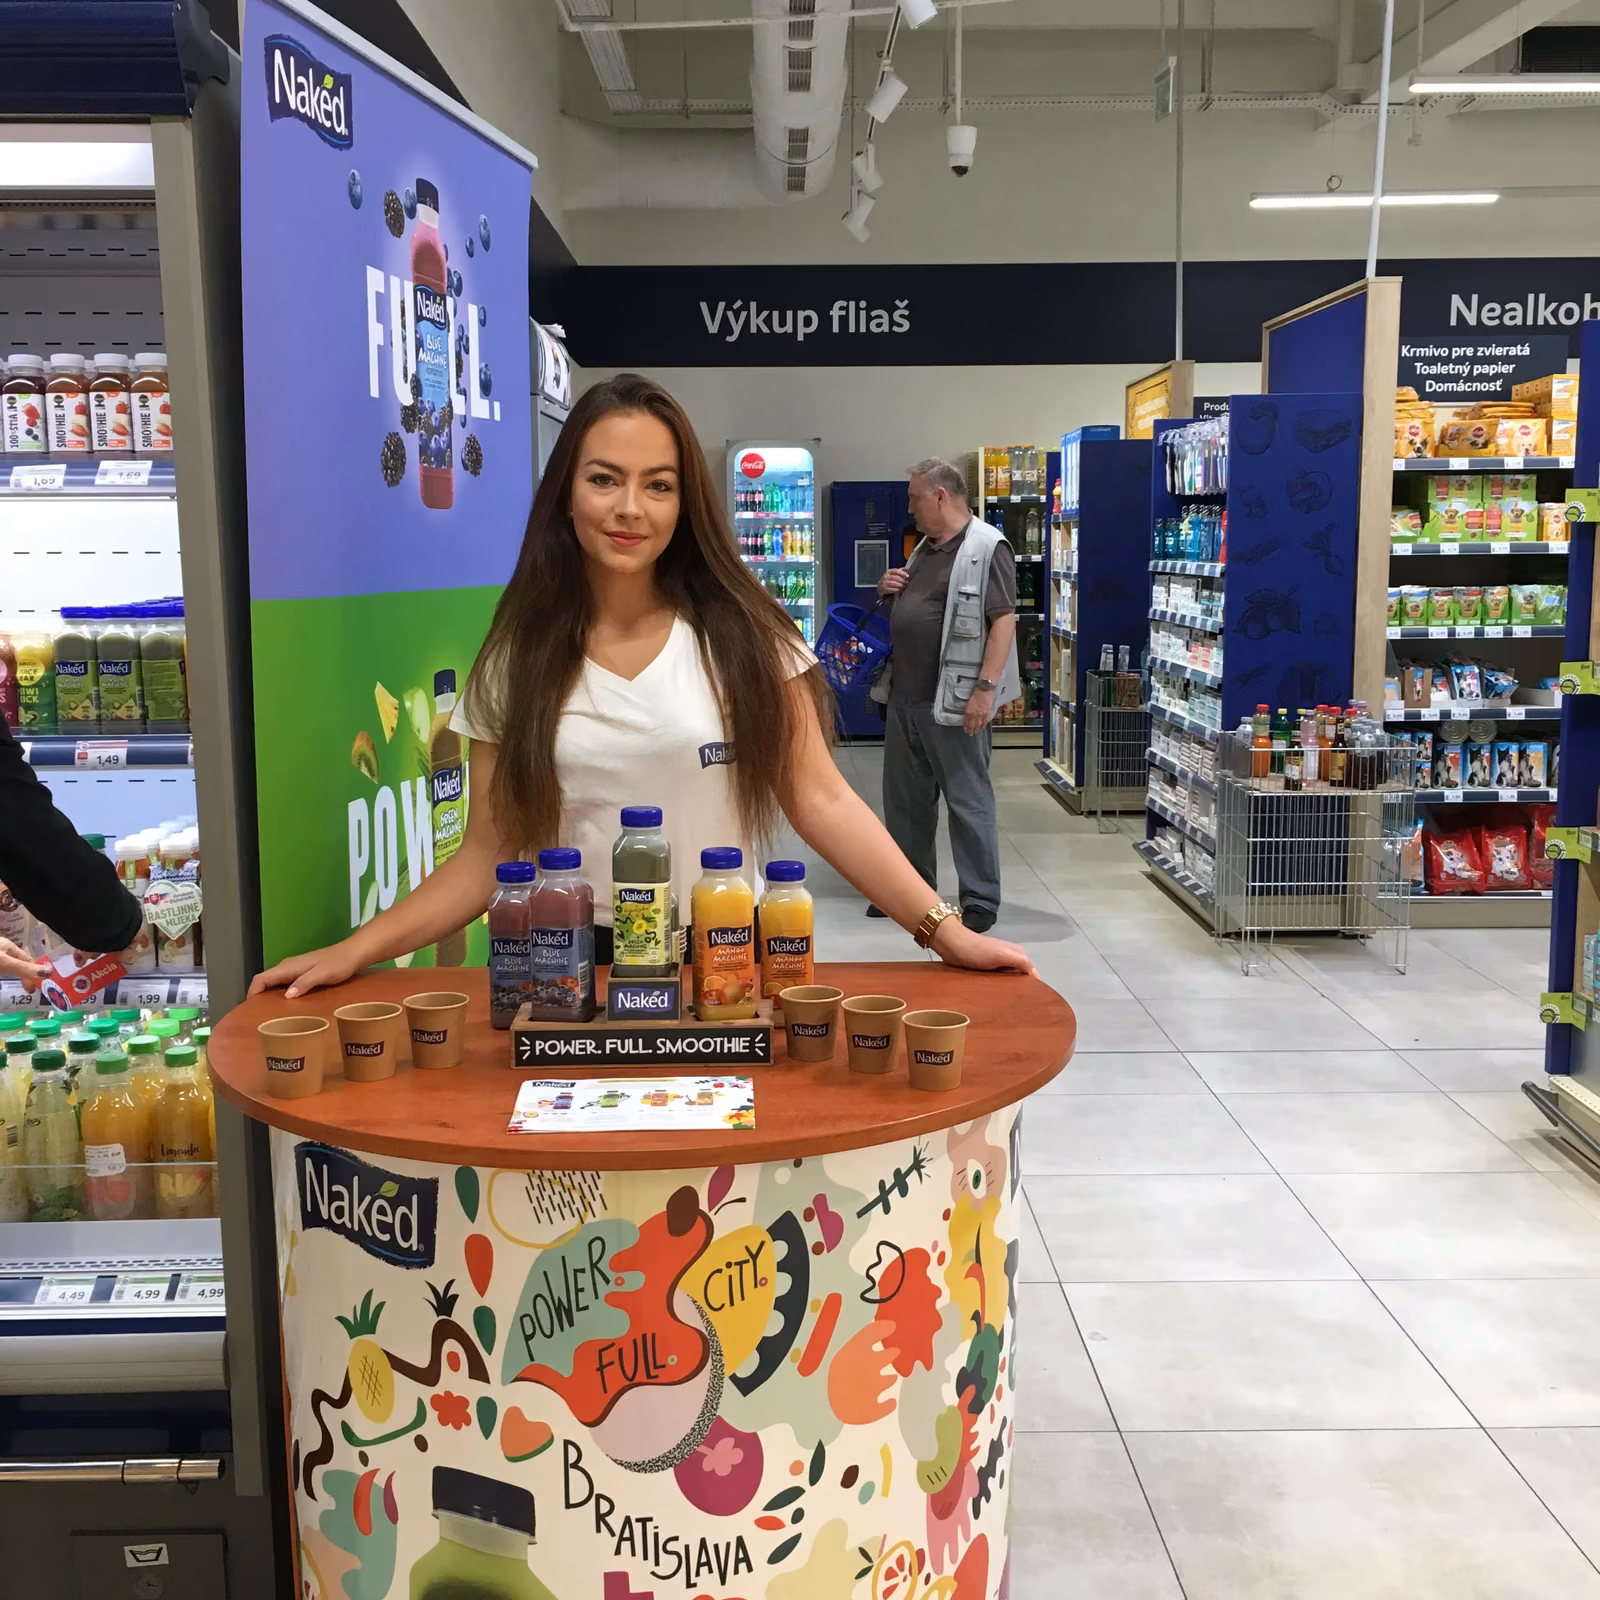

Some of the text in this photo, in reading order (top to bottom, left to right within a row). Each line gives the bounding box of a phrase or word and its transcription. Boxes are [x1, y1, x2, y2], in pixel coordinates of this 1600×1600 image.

[274, 48, 347, 136] Naked
[416, 290, 446, 323] Naked
[700, 299, 911, 342] Výkup fliaš
[1401, 343, 1531, 359] Krmivo pre zvieratá
[418, 348, 447, 369] MACHINE
[1414, 362, 1516, 377] Toaletný papier
[1425, 378, 1504, 392] Domácnosť
[56, 662, 85, 674] Naked
[100, 662, 128, 673] Naked
[97, 755, 119, 766] 1,49
[705, 746, 731, 764] Nak
[434, 775, 461, 801] Naked
[621, 890, 652, 902] Naked
[166, 914, 197, 927] MLIEKA
[532, 931, 569, 945] Naked
[711, 929, 749, 944] Naked
[494, 941, 530, 954] Naked
[770, 940, 806, 953] Naked
[542, 949, 561, 957] BLUE
[713, 953, 748, 962] MACHINE
[504, 957, 522, 965] BLUE
[534, 956, 569, 965] MACHINE
[772, 961, 805, 969] MACHINE
[90, 963, 118, 982] Akcia
[496, 964, 529, 972] MACHINE
[10, 994, 33, 1005] 1,29
[79, 994, 97, 1005] ,99
[138, 994, 161, 1005] 1,99
[618, 991, 669, 1009] Naked
[794, 1024, 827, 1036] Naked
[413, 1031, 444, 1042] Naked
[854, 1035, 887, 1048] Naked
[347, 1044, 381, 1056] Naked
[535, 1037, 751, 1056] POWER. FULL. SMOOTHIE
[916, 1051, 951, 1064] Naked
[268, 1059, 301, 1071] Naked
[304, 1157, 420, 1252] Naked
[58, 1290, 85, 1301] 4,49
[133, 1289, 160, 1300] 4,99
[197, 1287, 224, 1299] 4,99
